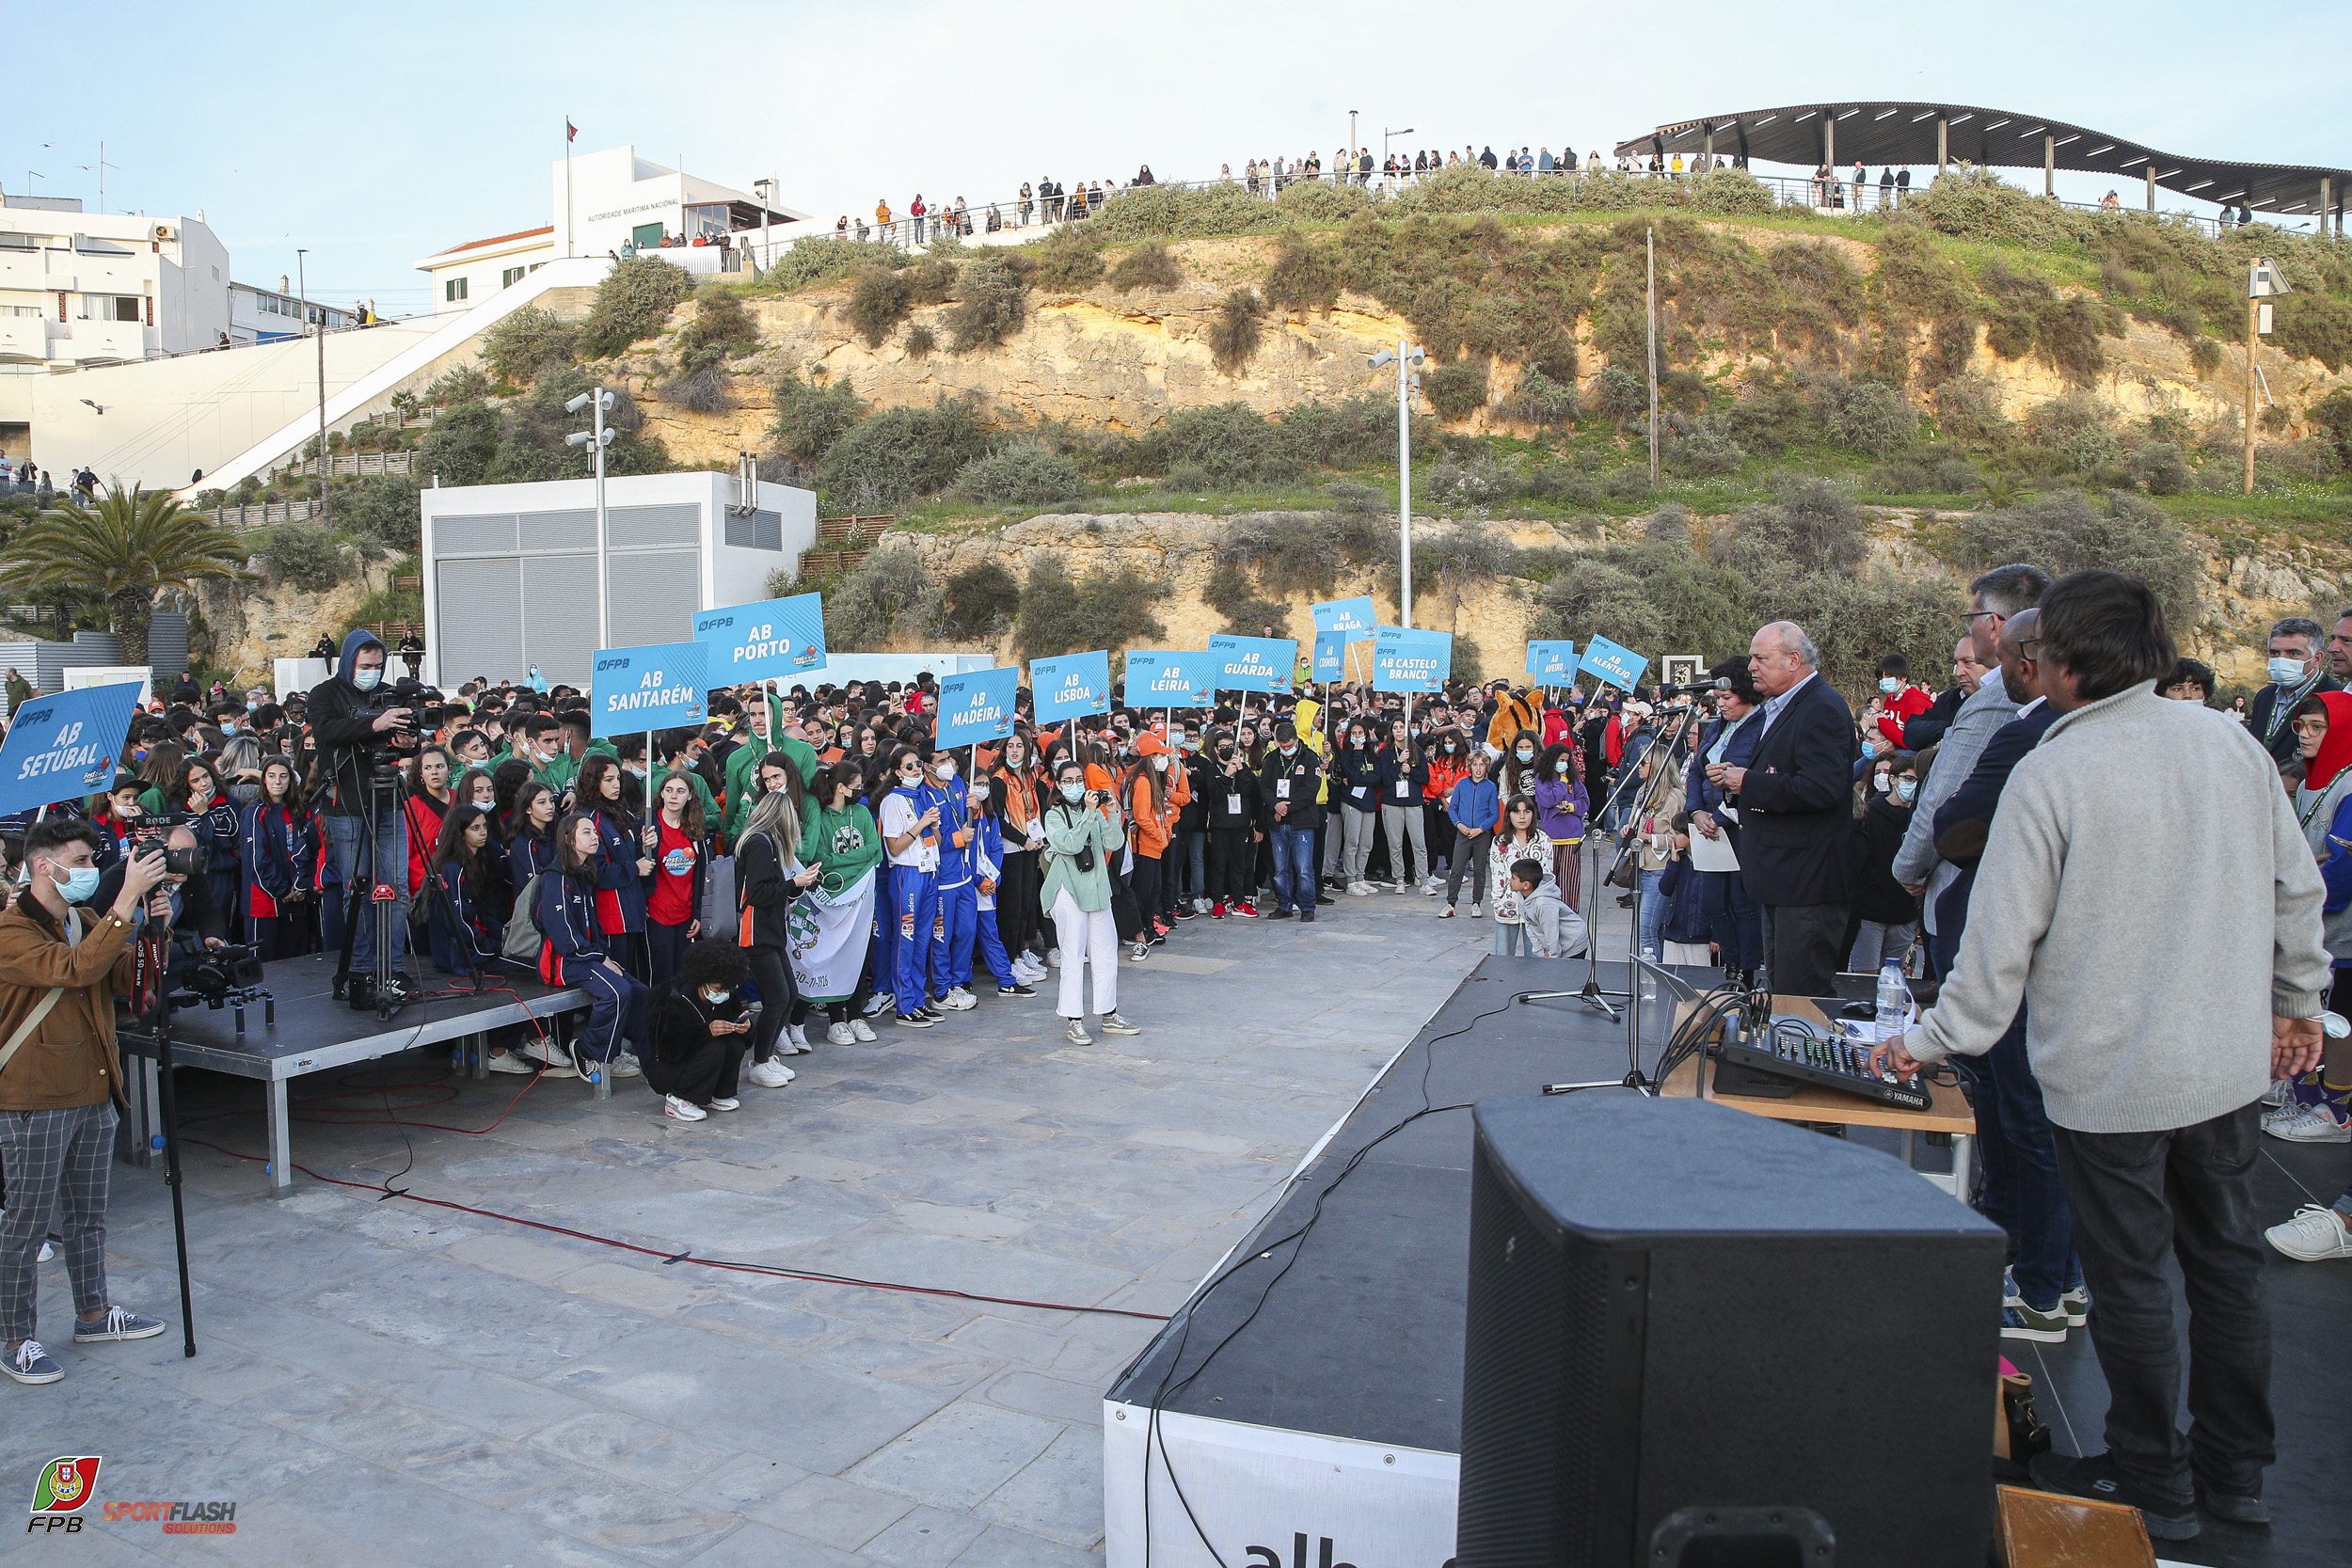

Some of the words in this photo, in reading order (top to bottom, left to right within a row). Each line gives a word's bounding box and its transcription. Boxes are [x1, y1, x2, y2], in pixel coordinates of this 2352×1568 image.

[588, 210, 621, 222] AUTORIDADE
[651, 198, 679, 210] NACIONAL
[1339, 611, 1351, 622] AB
[708, 617, 733, 630] FPB
[1333, 620, 1362, 631] BRAGA
[748, 624, 772, 642] AB
[733, 638, 790, 663] PORTO
[1326, 646, 1334, 656] AB
[606, 658, 630, 670] FPB
[1242, 652, 1260, 664] AB
[1319, 657, 1339, 668] COIMBRA
[1380, 658, 1394, 668] AB
[1396, 658, 1438, 669] CASTELO
[1551, 654, 1559, 663] AB
[1608, 655, 1622, 665] AB
[1041, 665, 1056, 675] FPB
[1162, 667, 1180, 679] AB
[1224, 663, 1273, 677] GUARDA
[1545, 663, 1563, 673] AVEIRO
[1591, 656, 1631, 679] ALENTEJO
[640, 671, 663, 689] AB
[1065, 673, 1080, 688] AB
[1389, 669, 1428, 680] BRANCO
[948, 683, 965, 693] FPB
[1151, 680, 1191, 691] LEIRIA
[607, 683, 694, 712] SANTARÉM
[970, 692, 986, 708] AB
[1055, 686, 1091, 704] LISBOA
[25, 708, 54, 727] FPB
[951, 705, 1001, 728] MADEIRA
[52, 721, 83, 749] AB
[17, 743, 98, 780] SETÚBAL
[1894, 1092, 1923, 1107] YAMAHA
